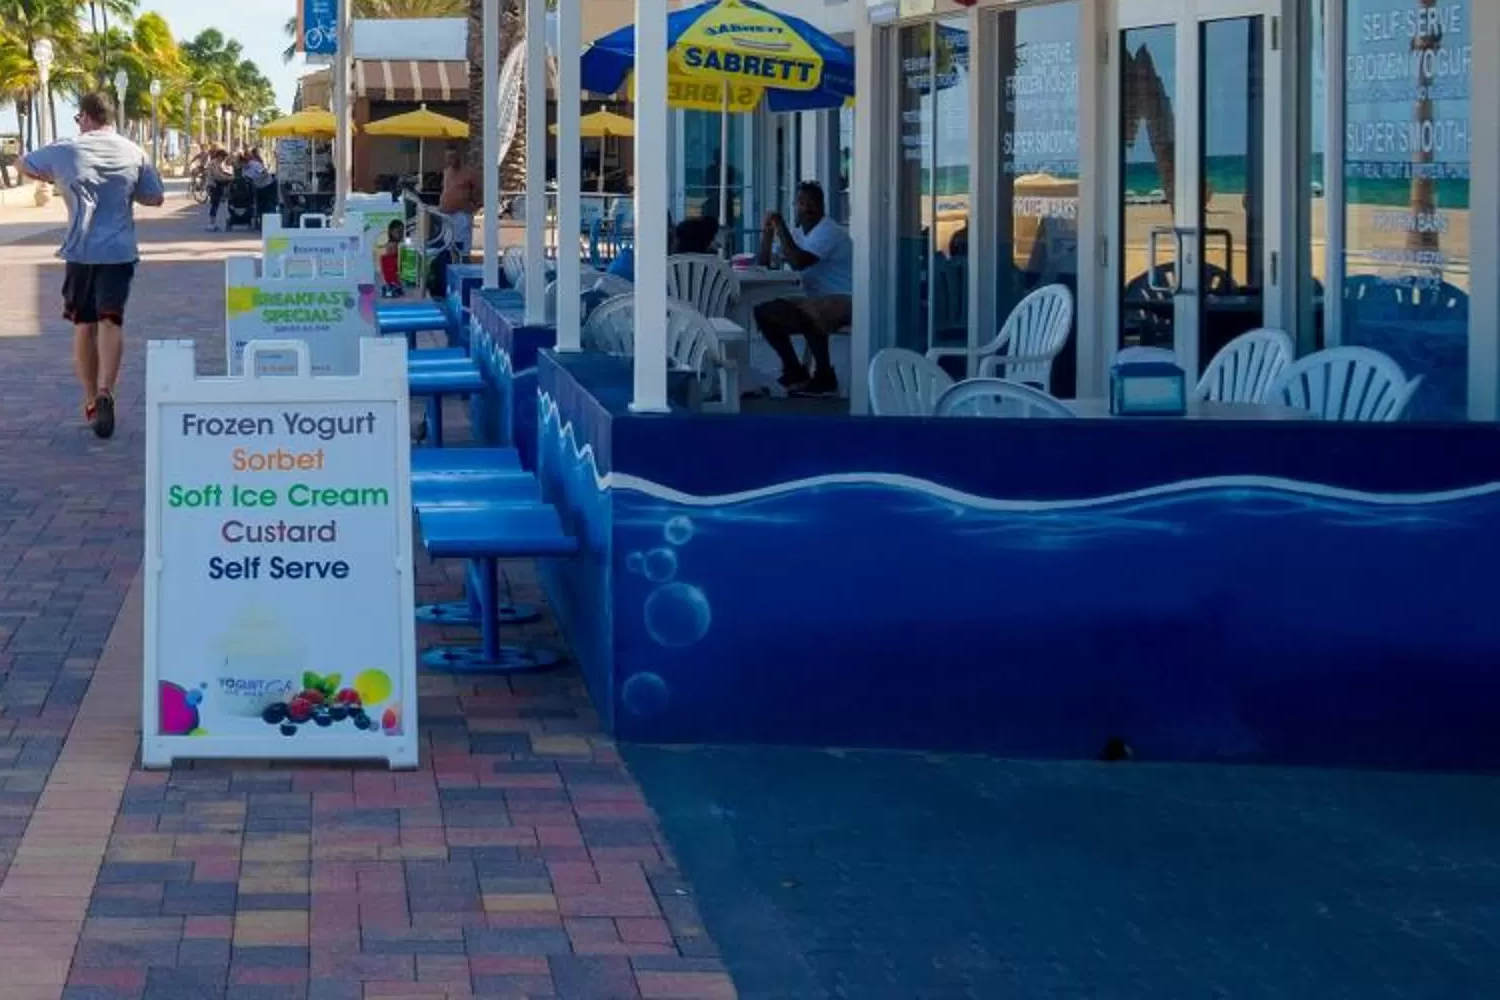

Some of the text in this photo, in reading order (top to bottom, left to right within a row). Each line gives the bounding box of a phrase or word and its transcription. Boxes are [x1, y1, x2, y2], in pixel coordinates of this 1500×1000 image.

[1363, 4, 1461, 41] SELF-SERVE
[685, 47, 815, 83] SABRETT
[1347, 49, 1410, 81] FROZEN
[1347, 121, 1395, 153] SUPER
[257, 291, 350, 306] BREAKFAST
[261, 308, 344, 323] SPECIALS
[182, 411, 376, 441] Frozen Yogurt
[232, 447, 324, 472] Sorbet
[168, 484, 390, 508] Soft Ice Cream
[221, 519, 337, 544] Custard
[209, 556, 350, 580] Self Serve
